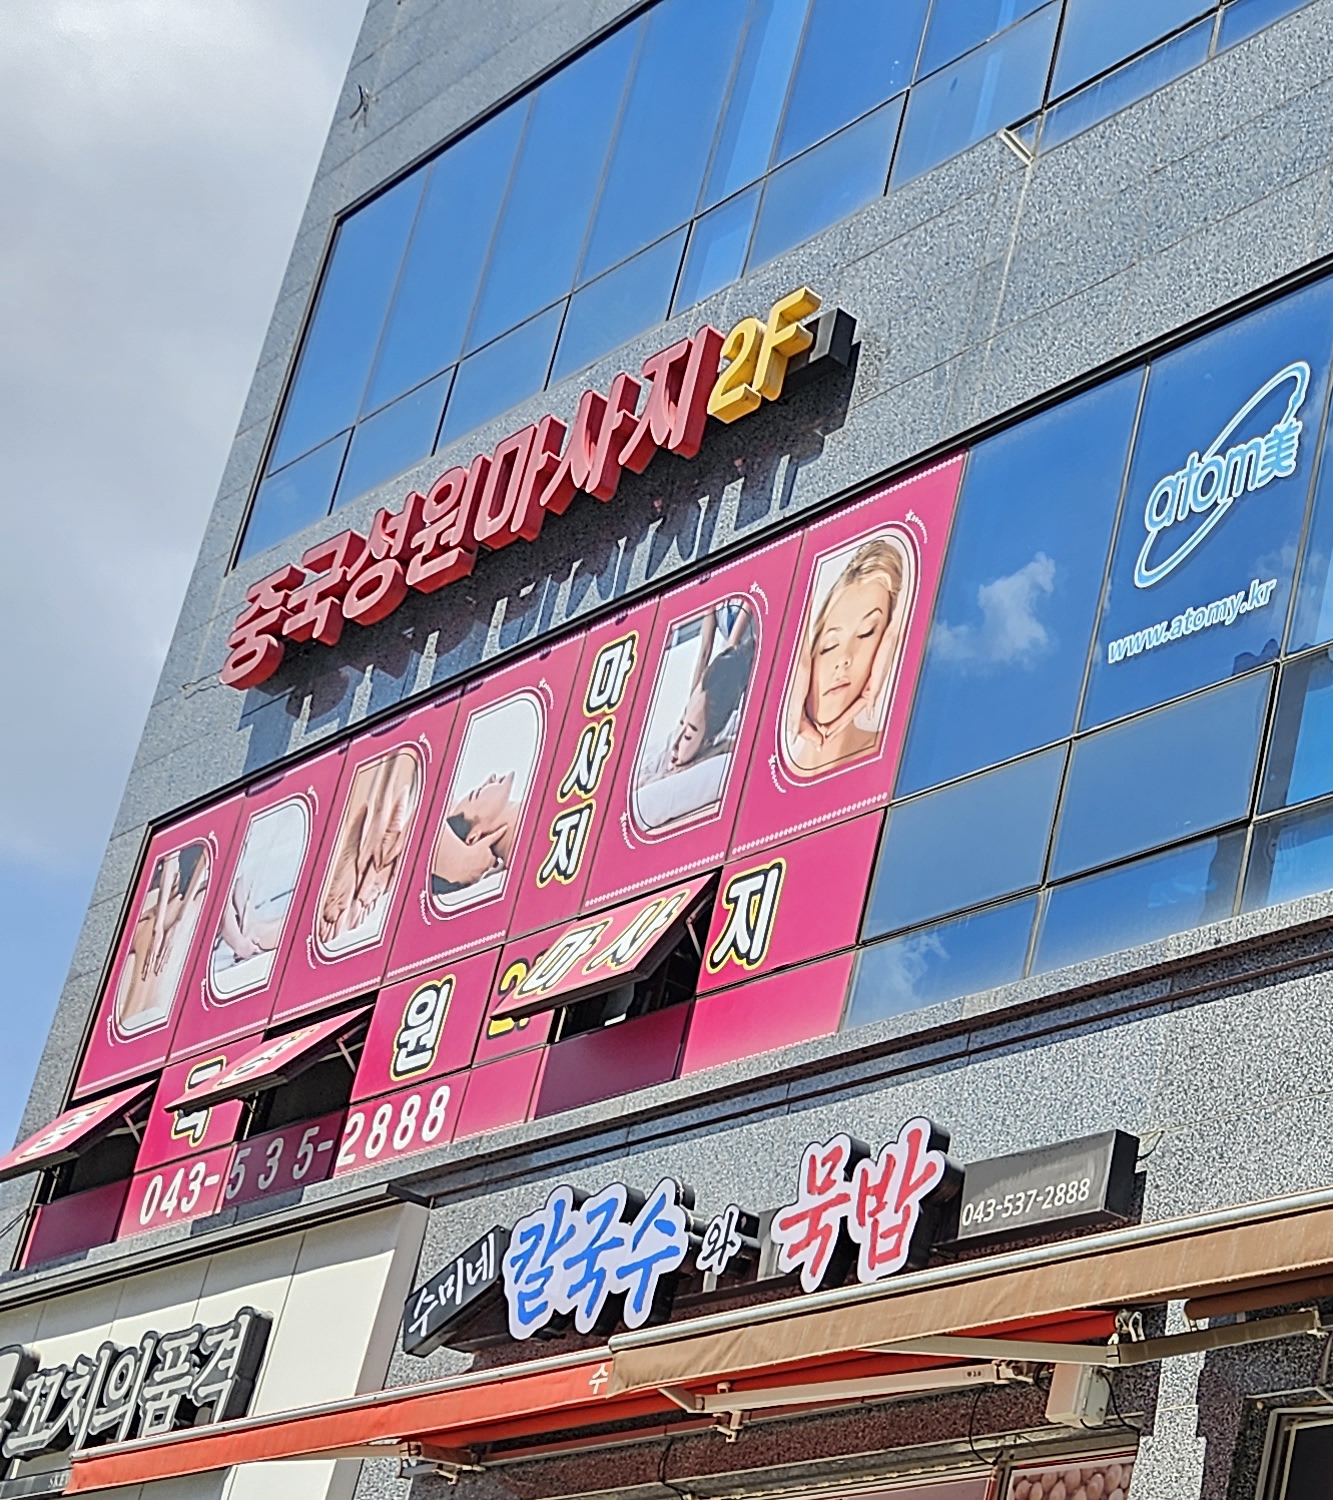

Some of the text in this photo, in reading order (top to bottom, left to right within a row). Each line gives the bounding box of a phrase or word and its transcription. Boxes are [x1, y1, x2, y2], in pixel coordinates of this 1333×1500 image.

[1106, 577, 1279, 666] www.atomy.kr
[138, 1083, 453, 1227] 043-535-2888
[961, 1177, 1091, 1227] 043-537-2888
[407, 1116, 944, 1342] 수미네 칼국수 와 묵밥
